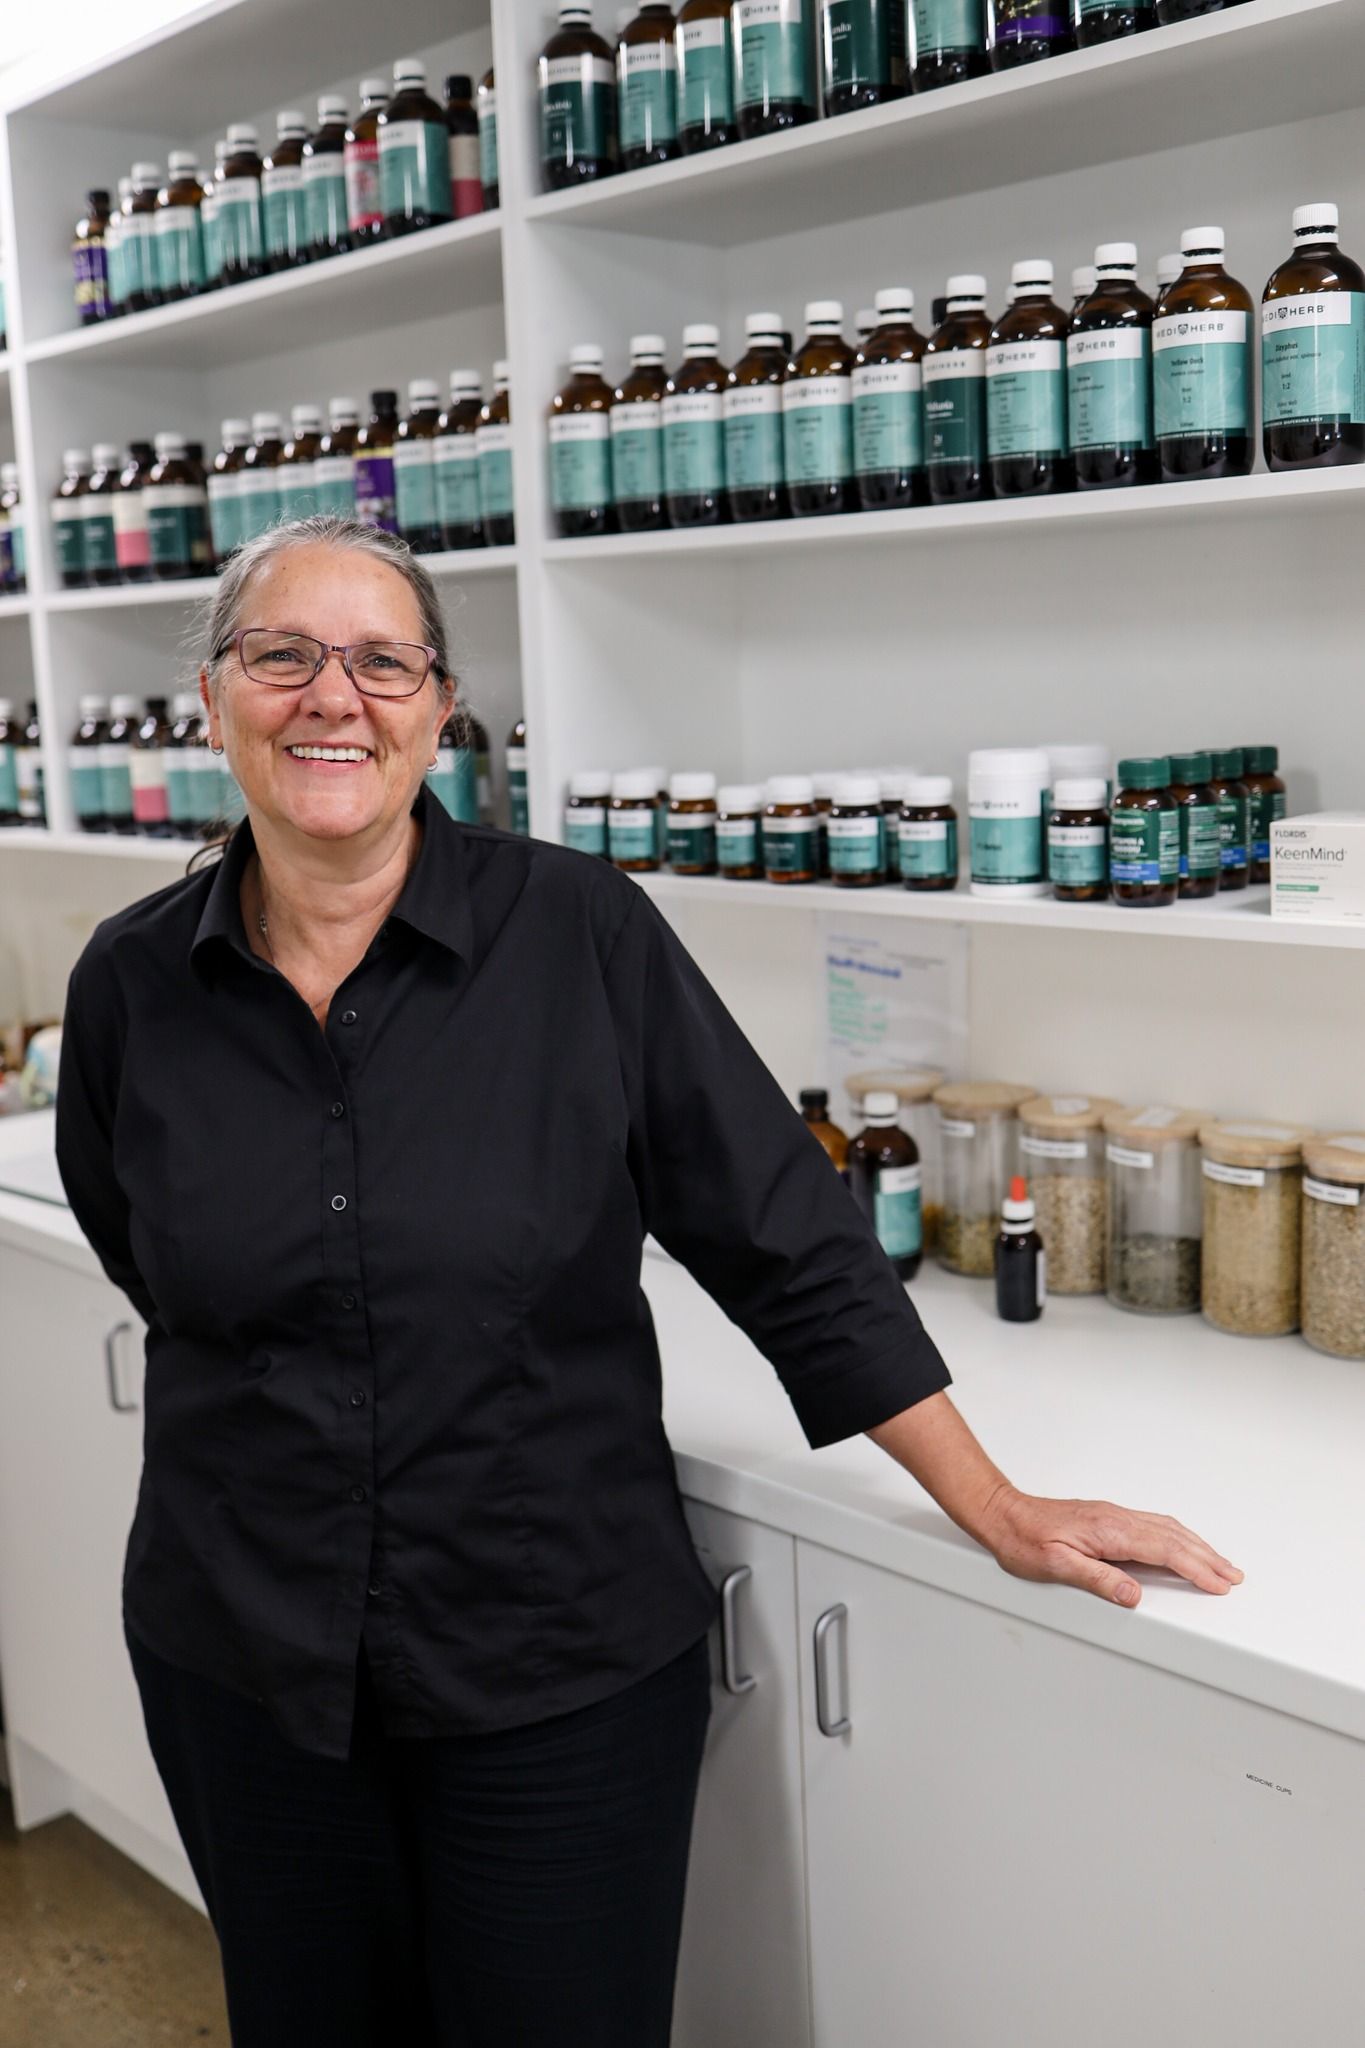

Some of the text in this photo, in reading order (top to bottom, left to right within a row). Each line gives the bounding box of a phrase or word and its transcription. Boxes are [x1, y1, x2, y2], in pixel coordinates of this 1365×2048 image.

[1289, 305, 1326, 316] HERB
[1190, 323, 1224, 332] HERB
[1275, 829, 1307, 839] FLORDIS
[1275, 845, 1345, 862] KeenMind
[1275, 1785, 1293, 1796] CUPS
